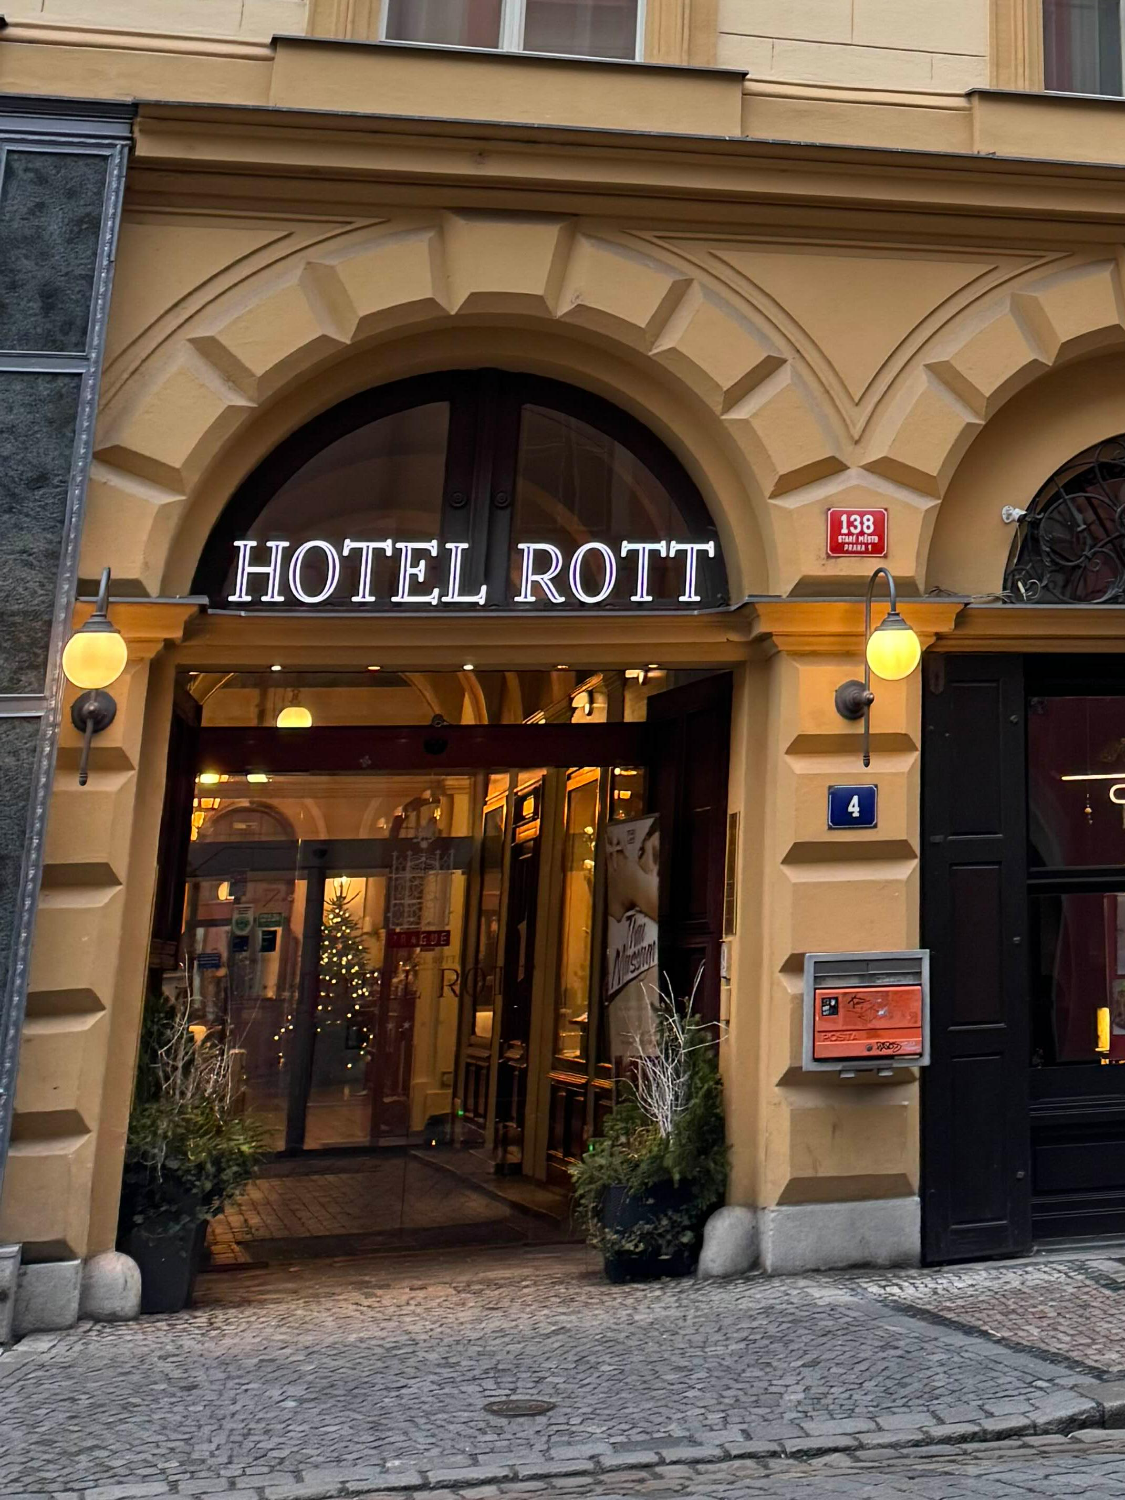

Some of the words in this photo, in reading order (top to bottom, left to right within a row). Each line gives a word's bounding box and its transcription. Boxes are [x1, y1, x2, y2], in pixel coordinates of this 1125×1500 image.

[841, 514, 874, 534] 138
[844, 544, 866, 552] PRAHA
[867, 544, 872, 552] 1
[227, 539, 487, 606] HOTEL
[513, 539, 715, 605] ROTT
[847, 795, 860, 817] 4
